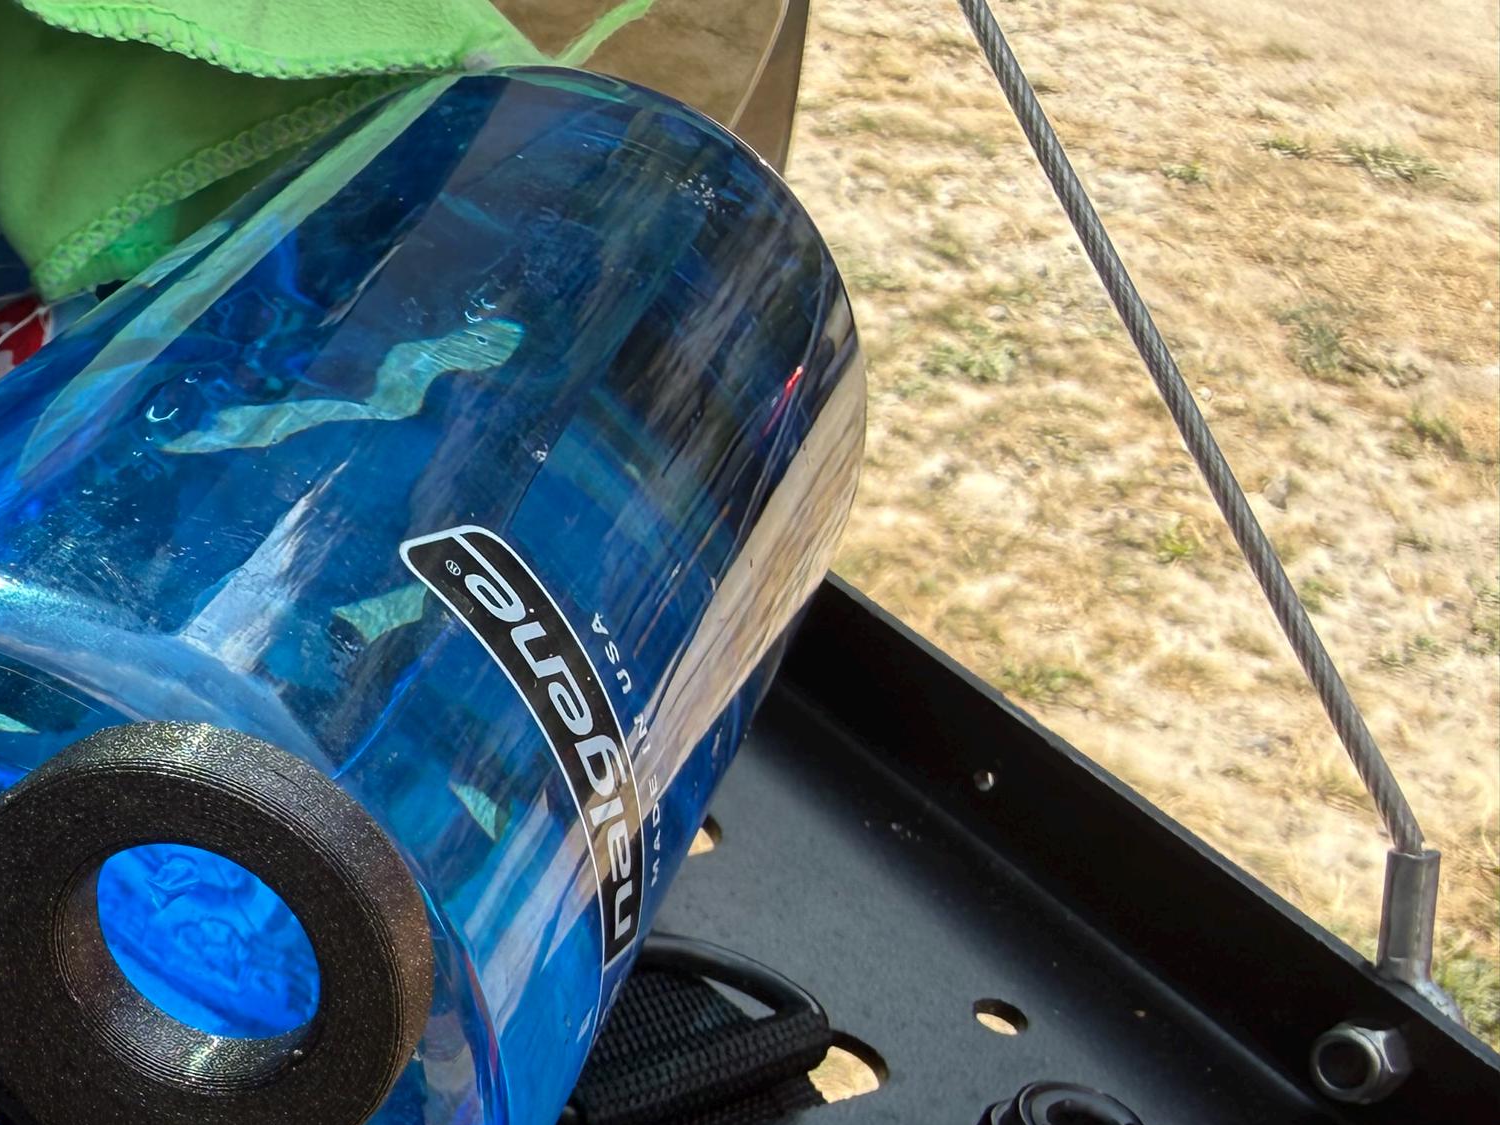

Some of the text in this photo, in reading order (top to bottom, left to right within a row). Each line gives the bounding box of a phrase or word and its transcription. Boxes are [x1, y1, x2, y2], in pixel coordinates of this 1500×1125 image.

[464, 573, 637, 940] nalgene
[589, 611, 662, 888] MADE IN USA
